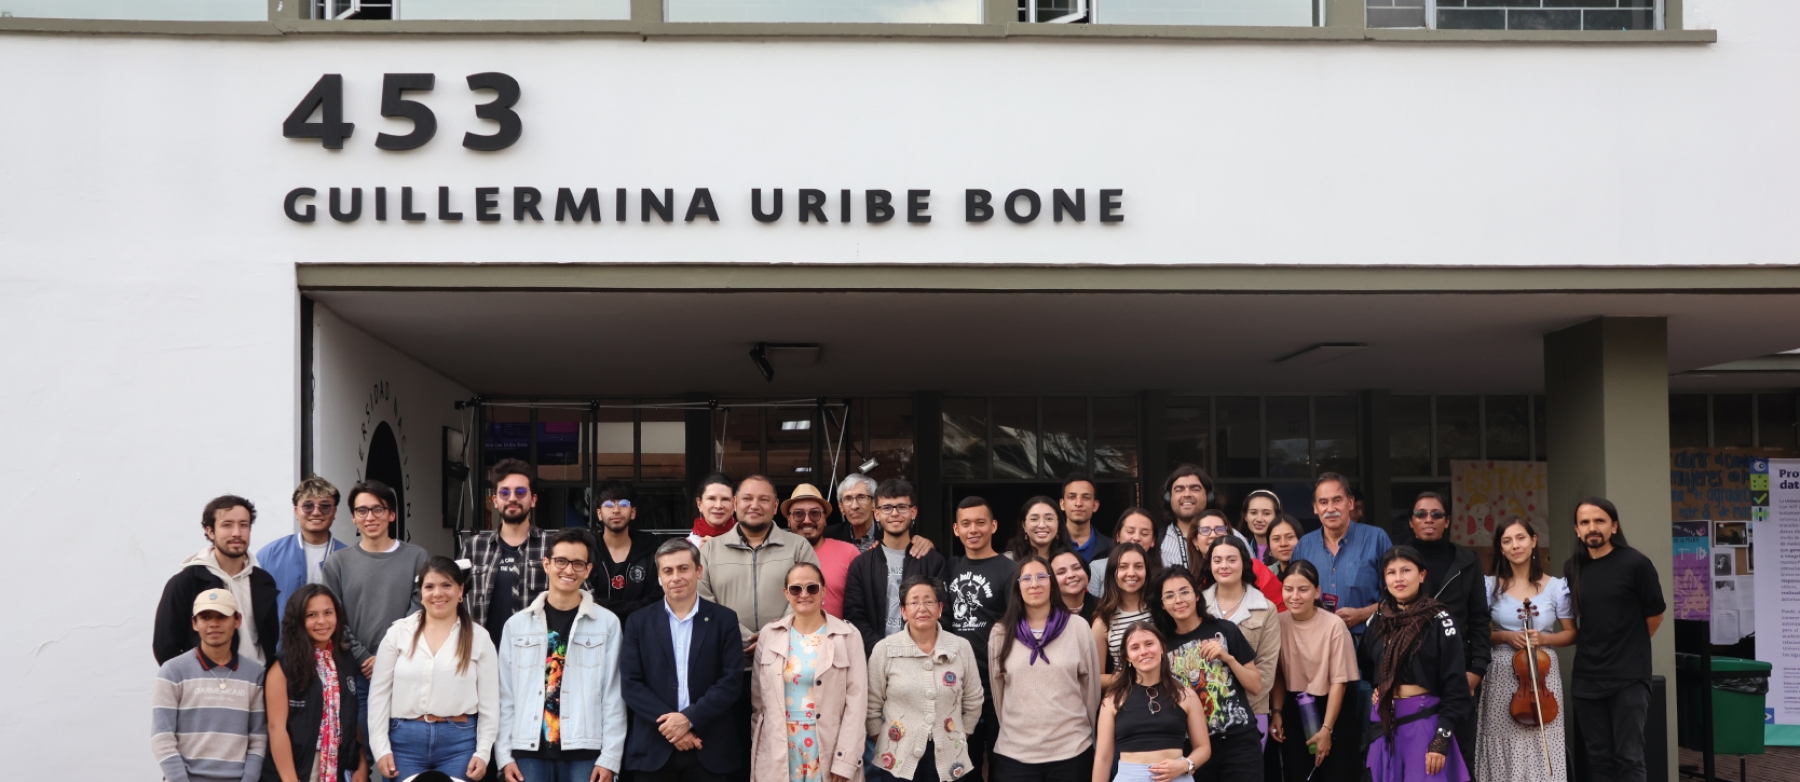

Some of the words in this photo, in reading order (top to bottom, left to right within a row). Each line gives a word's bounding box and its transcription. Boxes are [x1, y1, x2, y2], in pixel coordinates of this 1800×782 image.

[283, 72, 522, 151] 453
[284, 186, 720, 223] GUILLERMINA
[750, 187, 931, 224] URIBE
[965, 187, 1126, 224] BONE
[394, 395, 412, 544] NACIONA
[1779, 469, 1800, 478] Pro
